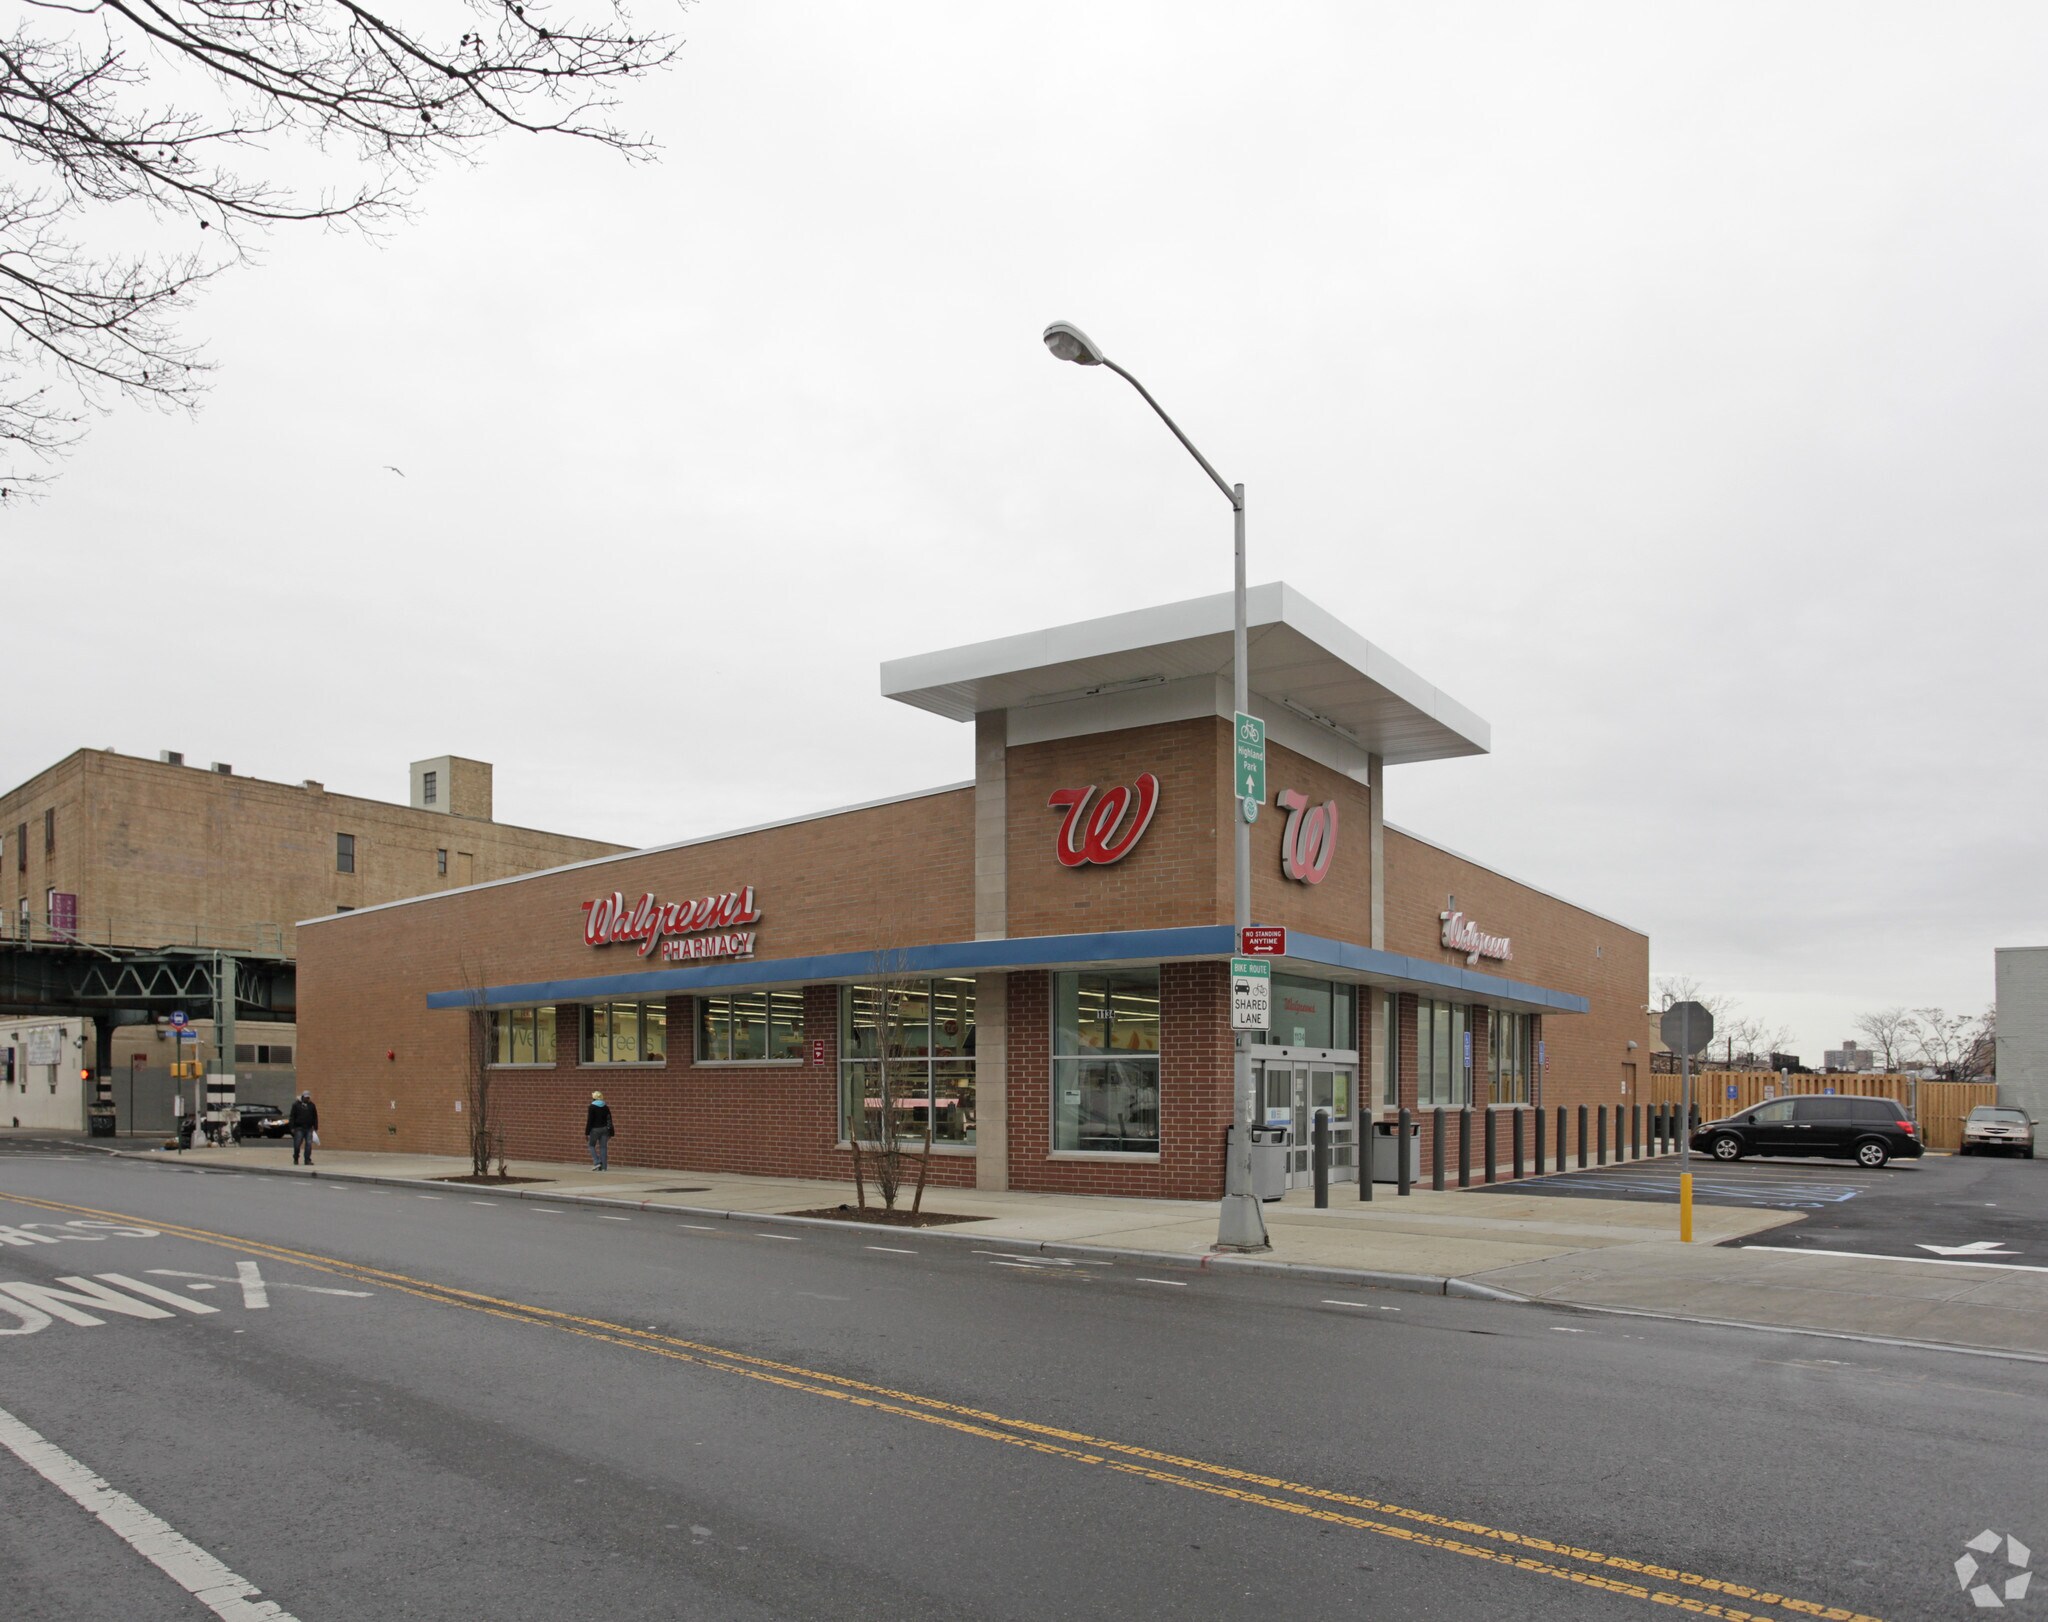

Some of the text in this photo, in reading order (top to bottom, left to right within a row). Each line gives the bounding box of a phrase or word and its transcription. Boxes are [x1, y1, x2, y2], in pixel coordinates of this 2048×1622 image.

[1237, 745, 1264, 760] Highland
[1243, 760, 1257, 772] Park
[1047, 771, 1159, 867] W
[1276, 788, 1338, 885] W
[581, 886, 761, 956] Walgreens
[662, 931, 756, 961] PHARMACY
[1234, 963, 1267, 975] BIKE ROUTE
[1234, 998, 1268, 1011] SHARED
[1240, 1013, 1262, 1024] LANE
